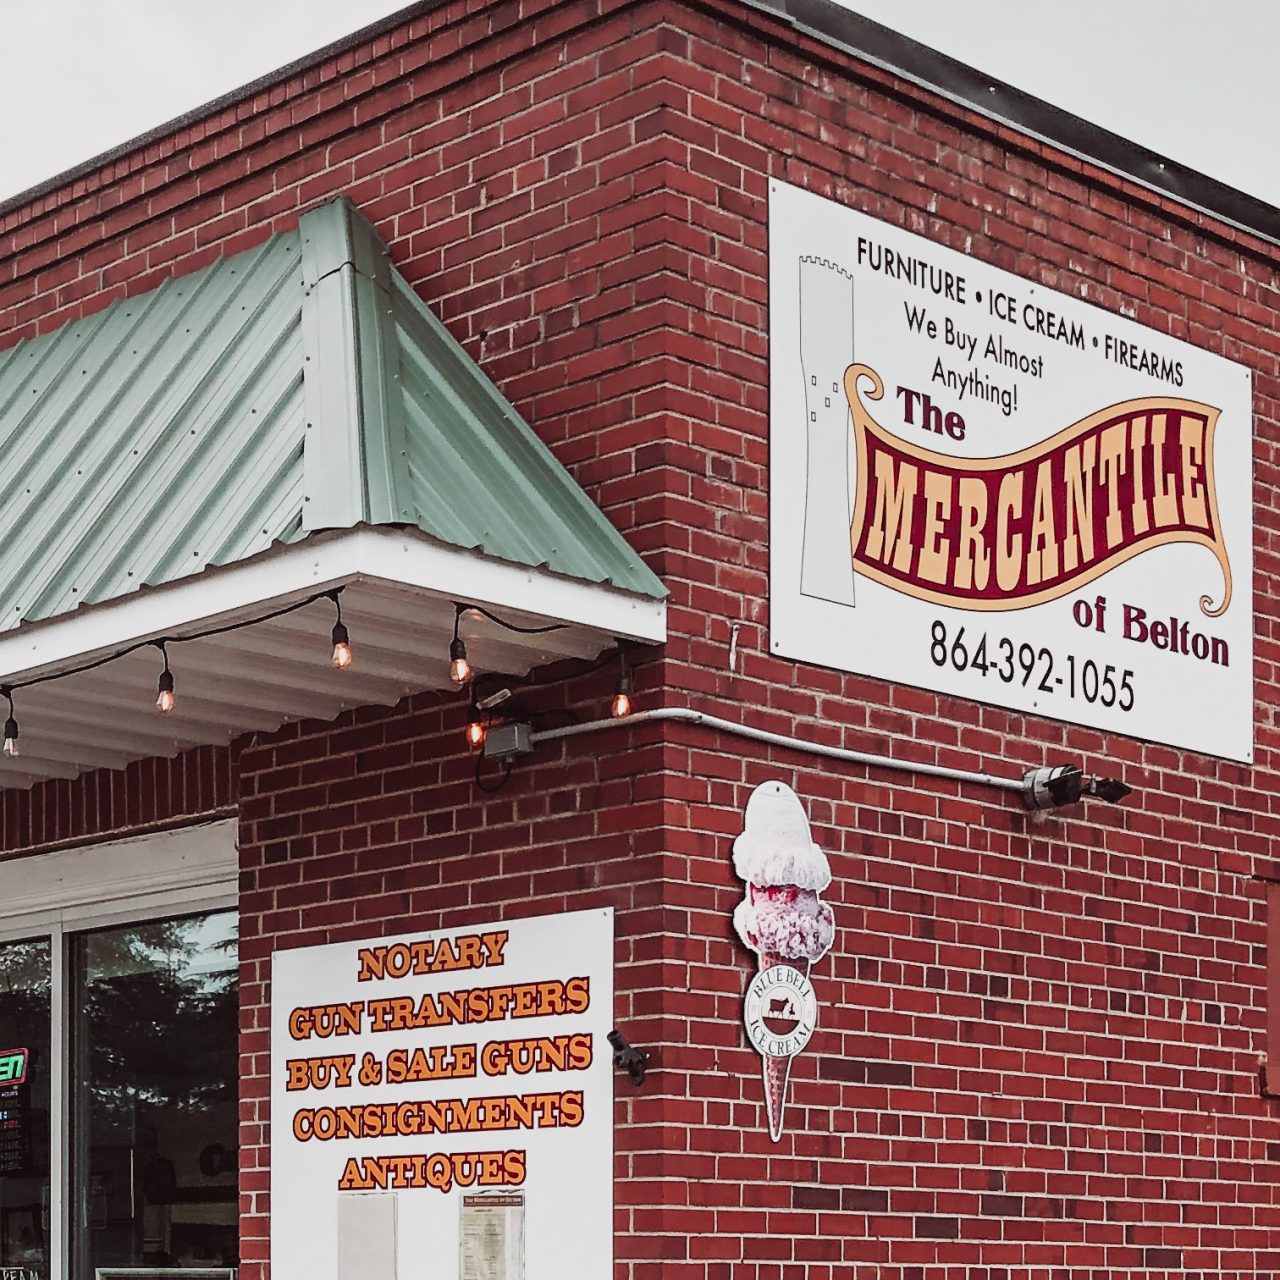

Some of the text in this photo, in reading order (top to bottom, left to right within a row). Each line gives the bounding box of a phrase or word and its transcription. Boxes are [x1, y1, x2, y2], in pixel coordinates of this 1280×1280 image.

[857, 237, 1183, 387] FURNITURE ICE CREAM FIREARMS
[904, 301, 1044, 378] We Buy Almost
[897, 385, 966, 441] The
[931, 357, 1018, 416] Anything!
[865, 413, 1209, 591] MERCANTILE
[1073, 596, 1230, 667] of Belton
[930, 620, 1135, 711] 864-392-1055
[357, 930, 509, 982] NOTARY
[754, 968, 812, 1002] BLUE BELL
[288, 976, 590, 1041] GUN TRANSFERS
[750, 1020, 811, 1055] ICE CREAM
[286, 1033, 593, 1092] BUY & SALE GUNS
[293, 1091, 584, 1142] CONSIGNMENTS
[338, 1150, 526, 1193] ANTIQUES
